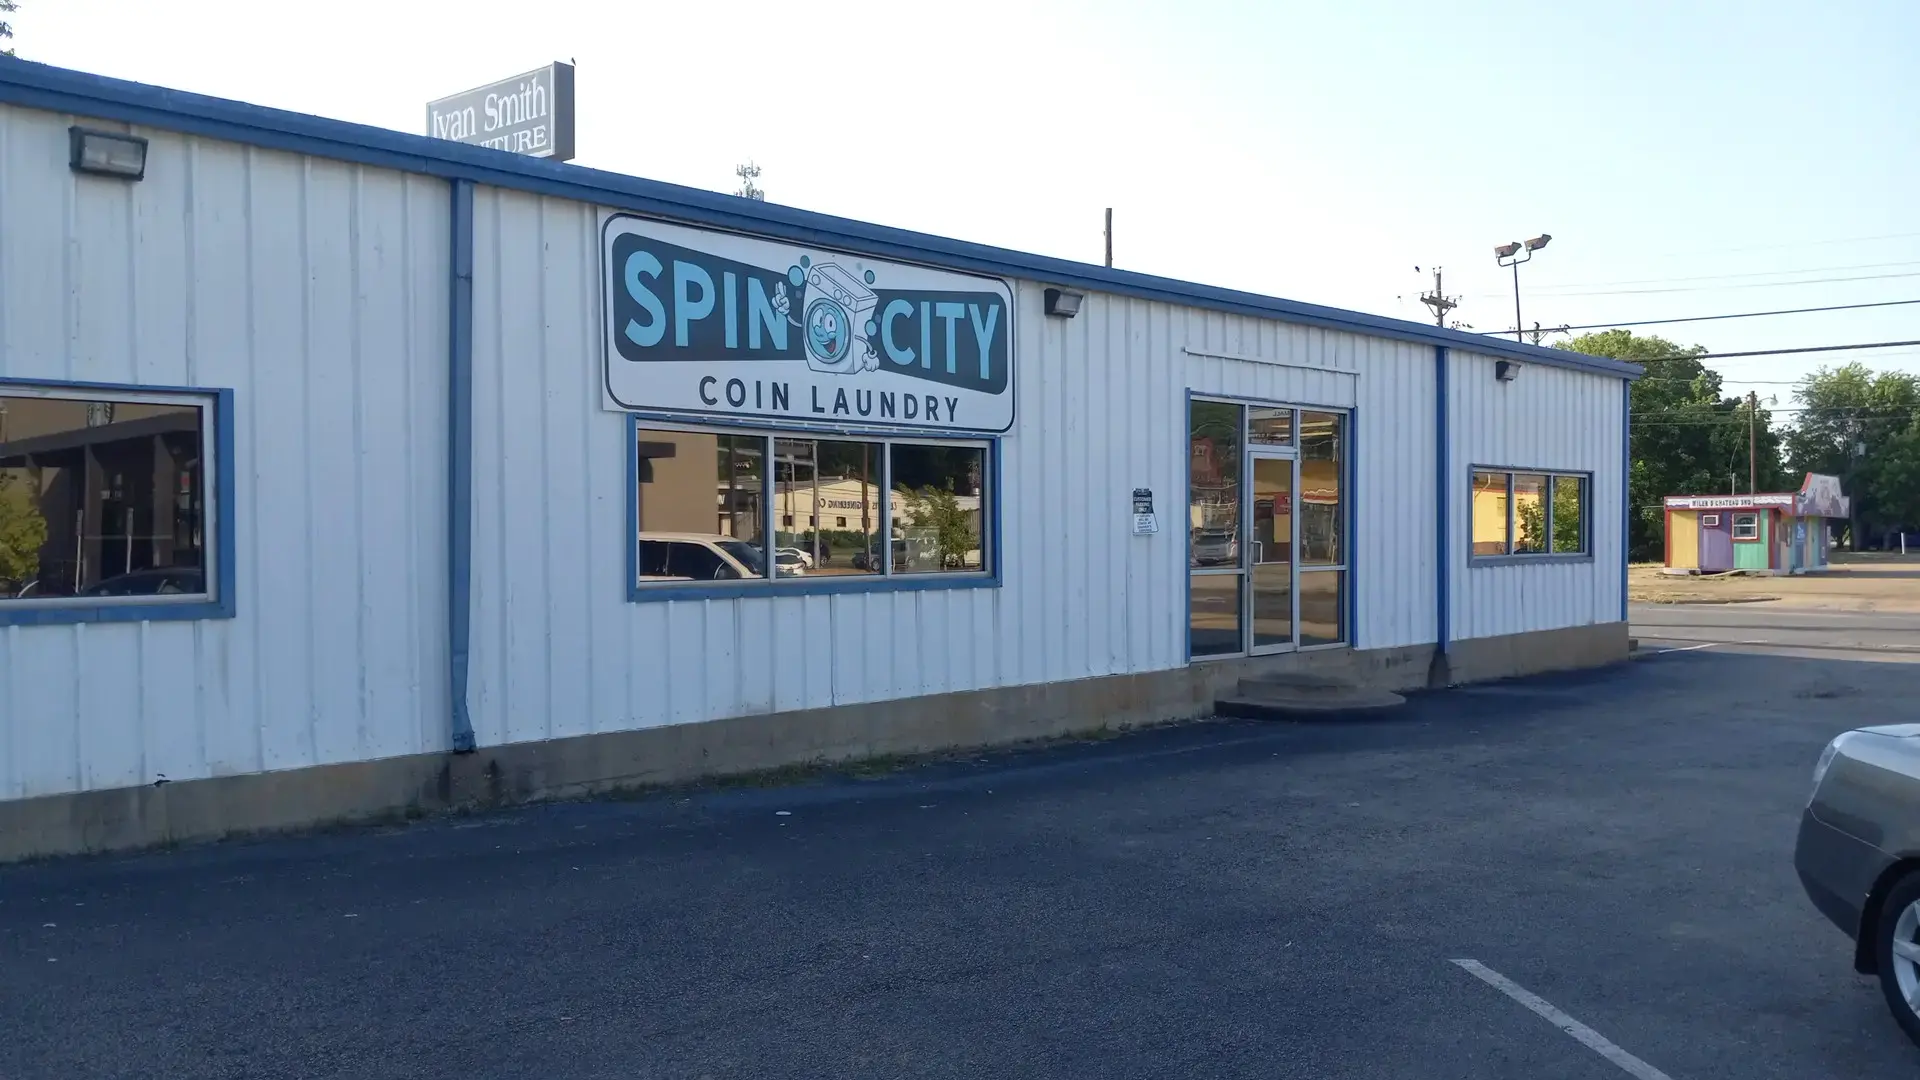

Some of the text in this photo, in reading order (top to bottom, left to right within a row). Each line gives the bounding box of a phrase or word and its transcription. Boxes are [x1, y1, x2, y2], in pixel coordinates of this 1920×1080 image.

[432, 77, 547, 141] Ivan Smith
[624, 250, 1000, 380] SPIN CITY
[699, 375, 959, 422] COIN LAUNDRY
